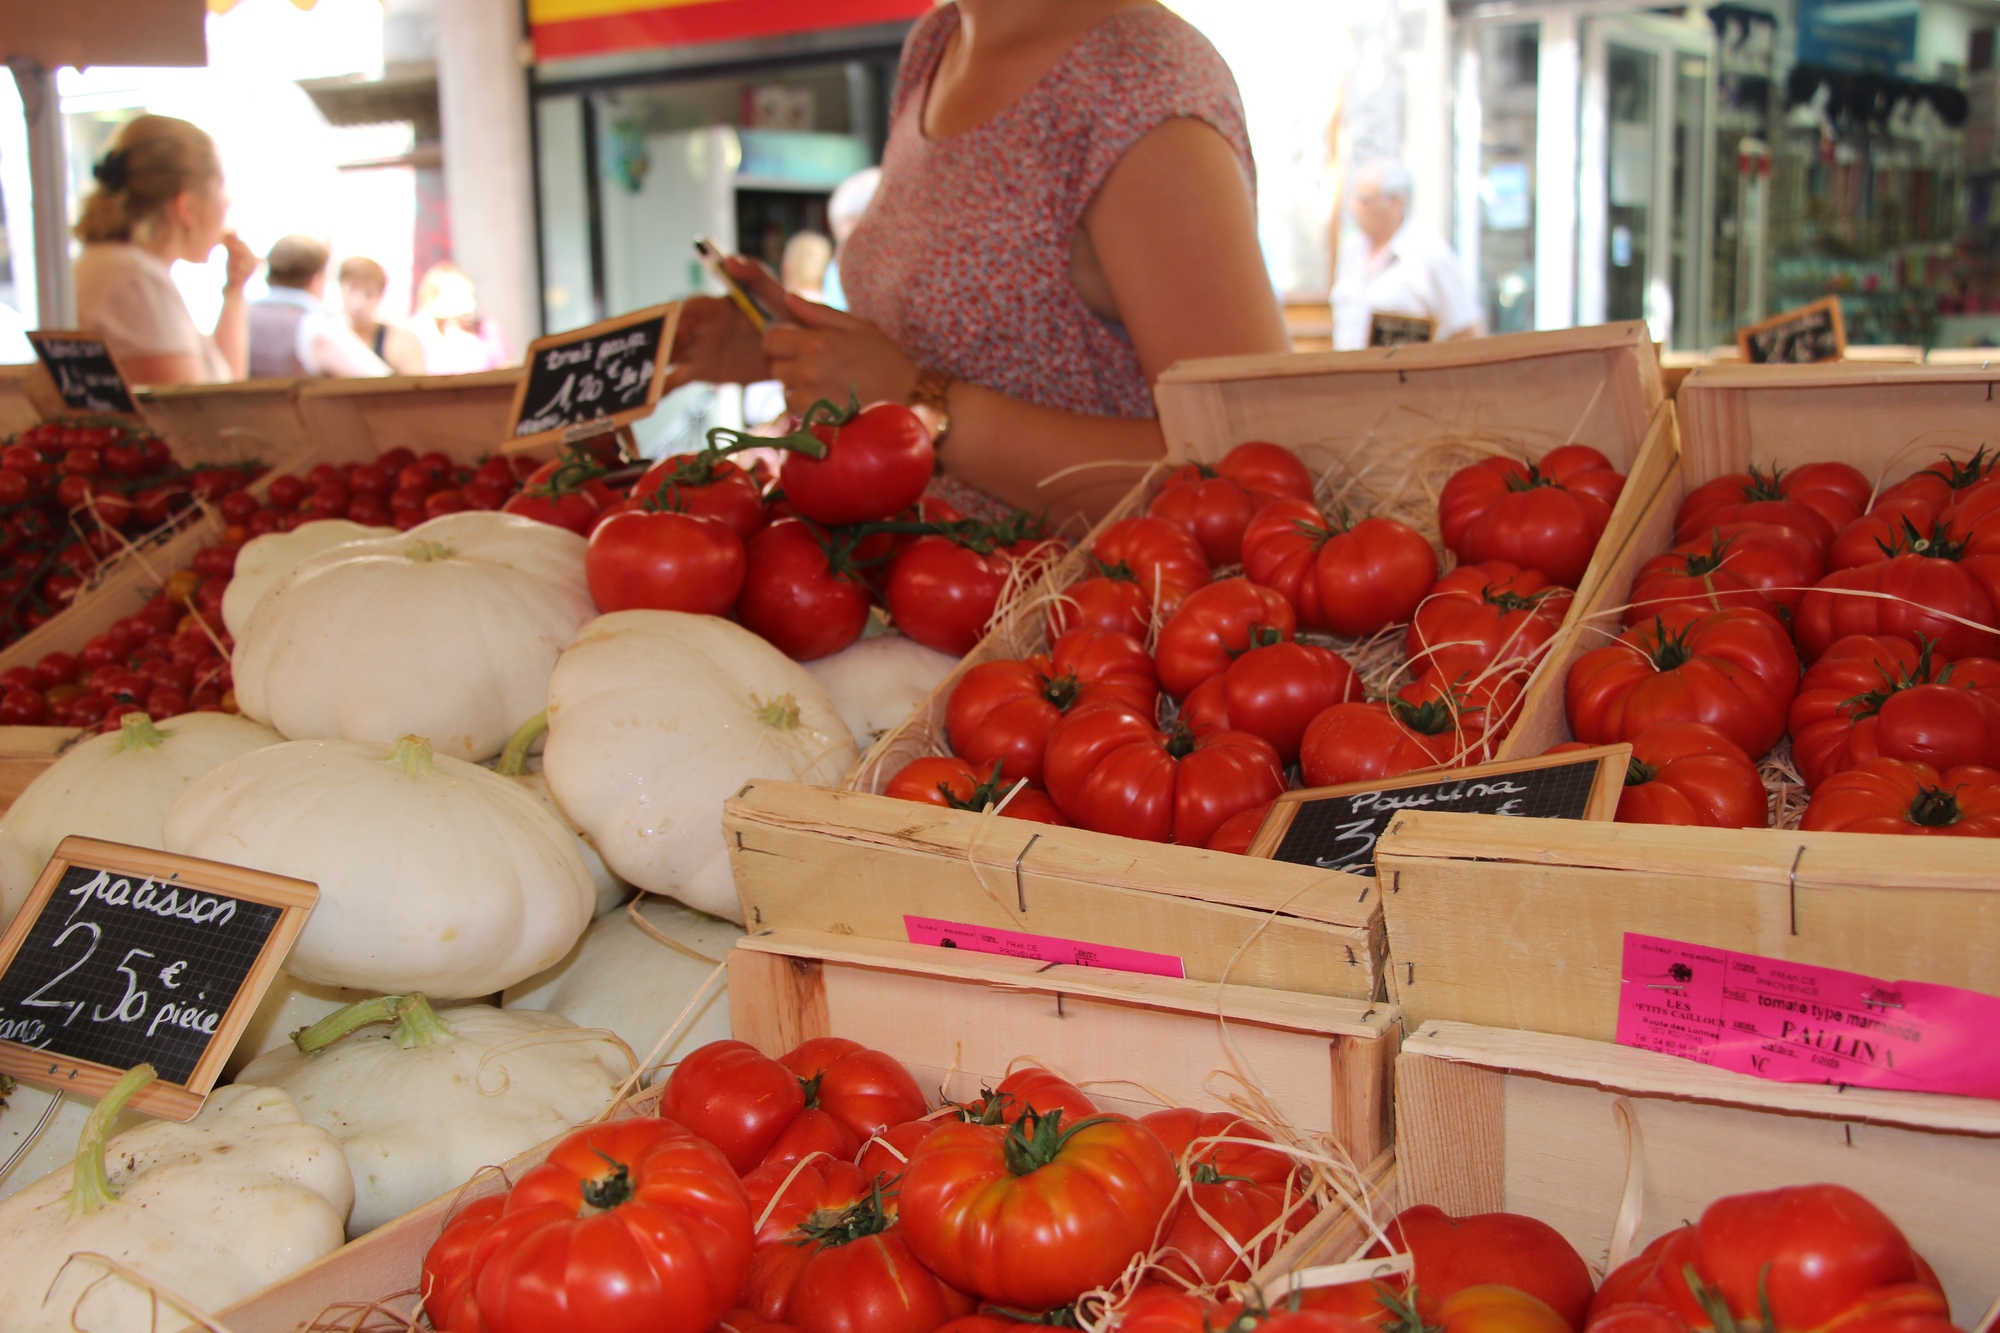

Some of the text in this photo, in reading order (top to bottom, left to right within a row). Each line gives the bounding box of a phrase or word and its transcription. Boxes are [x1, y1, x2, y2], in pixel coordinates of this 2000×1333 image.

[1006, 941, 1037, 952] FRANCE
[1770, 969, 1817, 986] FRANCE
[1756, 977, 1820, 997] PROVENCE
[1666, 999, 1691, 1012] LES
[1757, 994, 1807, 1014] tomate
[1811, 1004, 1843, 1022] type
[1642, 1016, 1668, 1028] Route
[1671, 1009, 1726, 1028] CAILLOUX
[1781, 1020, 1895, 1069] PAULINA
